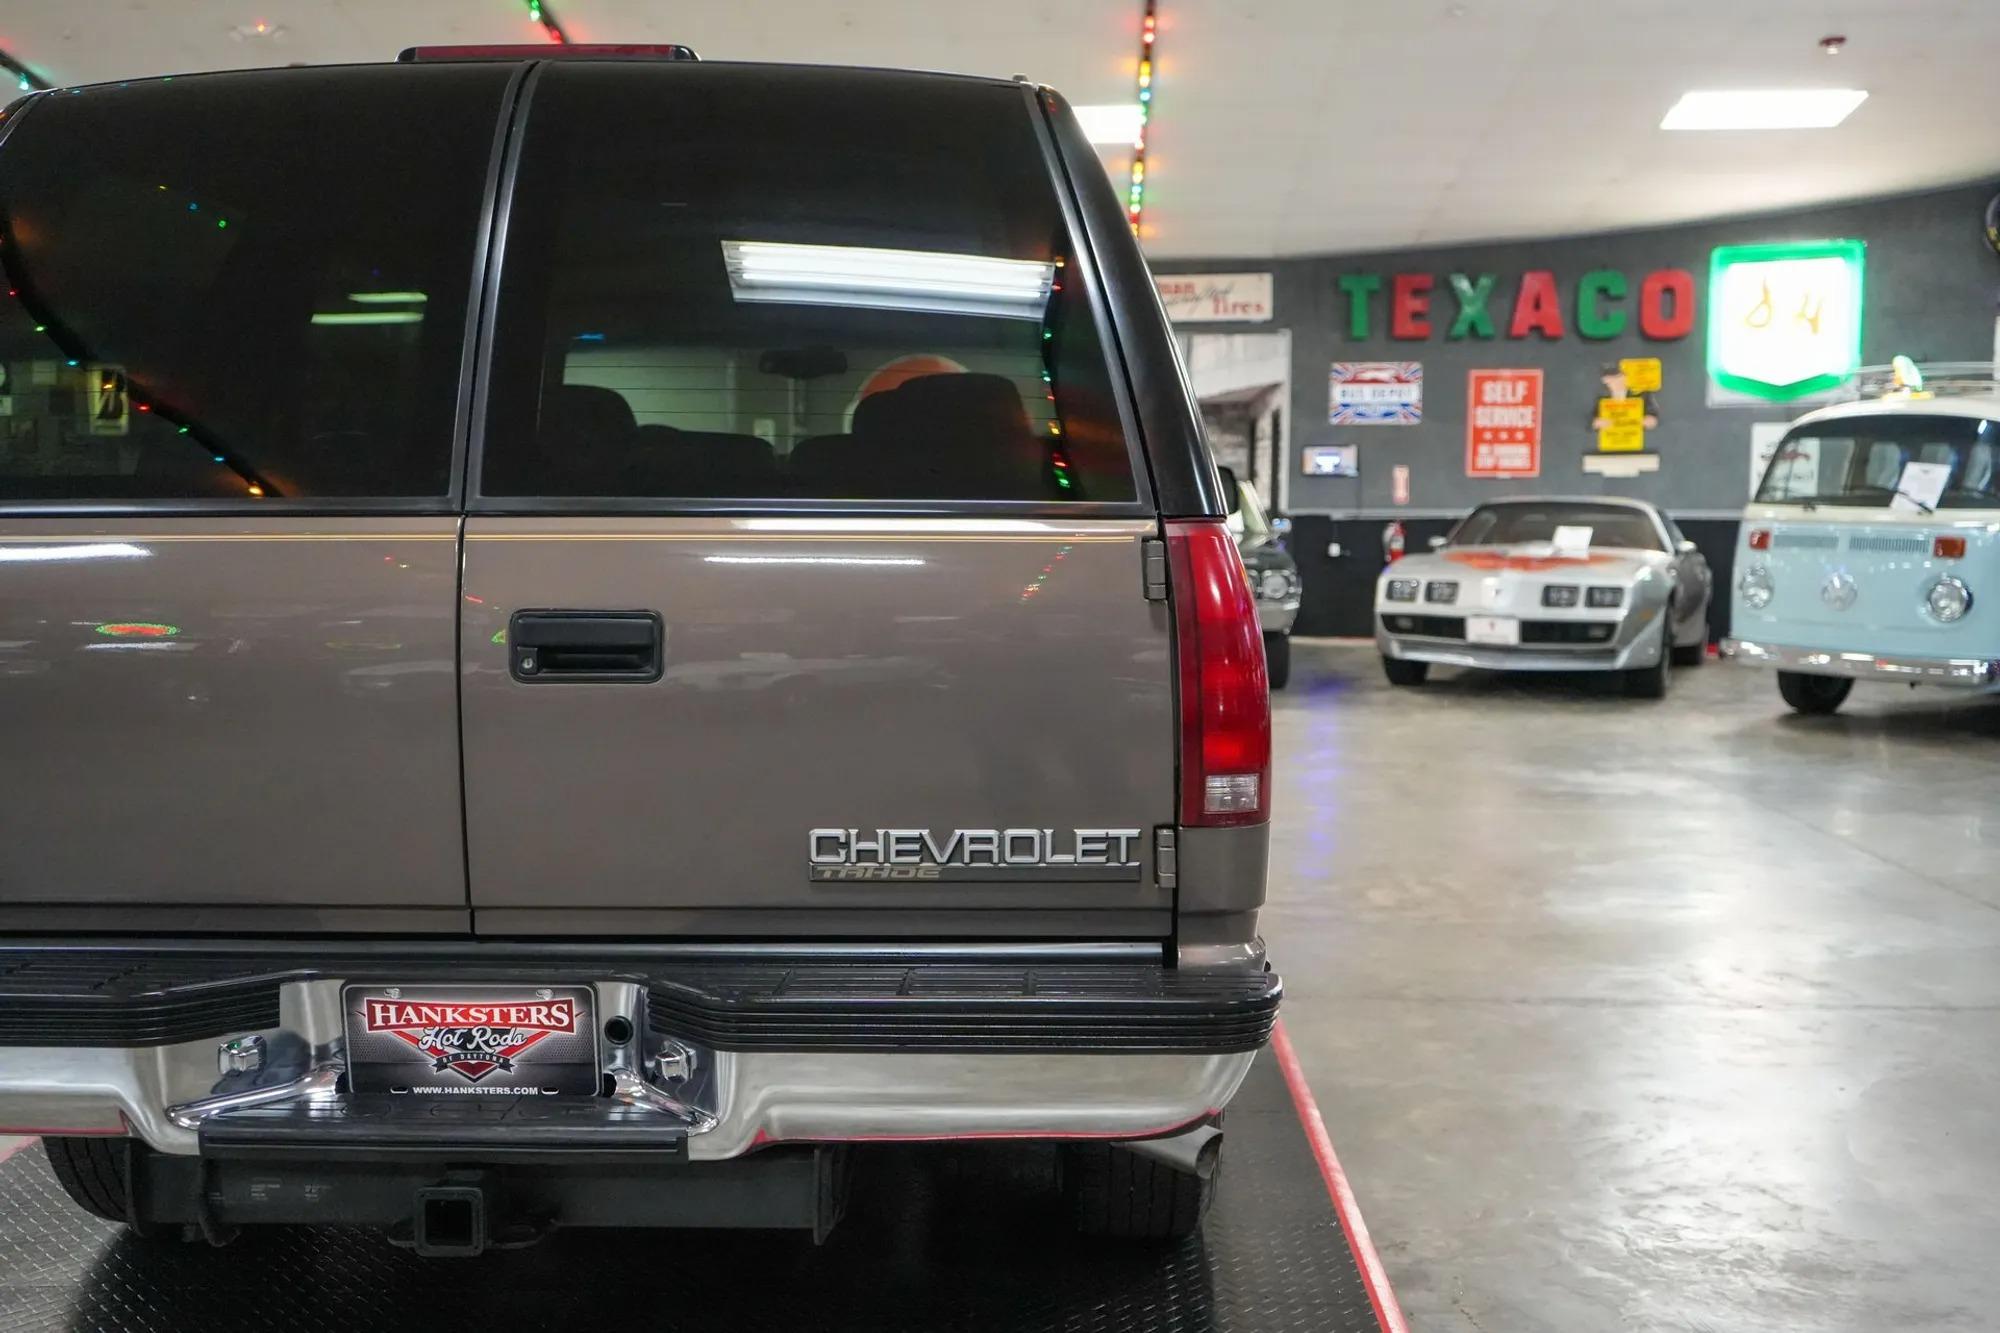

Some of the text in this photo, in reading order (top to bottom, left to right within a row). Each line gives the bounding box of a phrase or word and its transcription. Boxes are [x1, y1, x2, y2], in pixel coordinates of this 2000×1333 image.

[1338, 268, 1696, 341] TEXACO
[1482, 380, 1529, 404] SELF
[808, 828, 1141, 863] CHEVROLET
[816, 866, 943, 879] TAHOE
[372, 1002, 571, 1028] HANKSTERS
[418, 1025, 528, 1054] Hot Rods
[412, 1085, 539, 1096] WWW.HANKSTERS.COM
